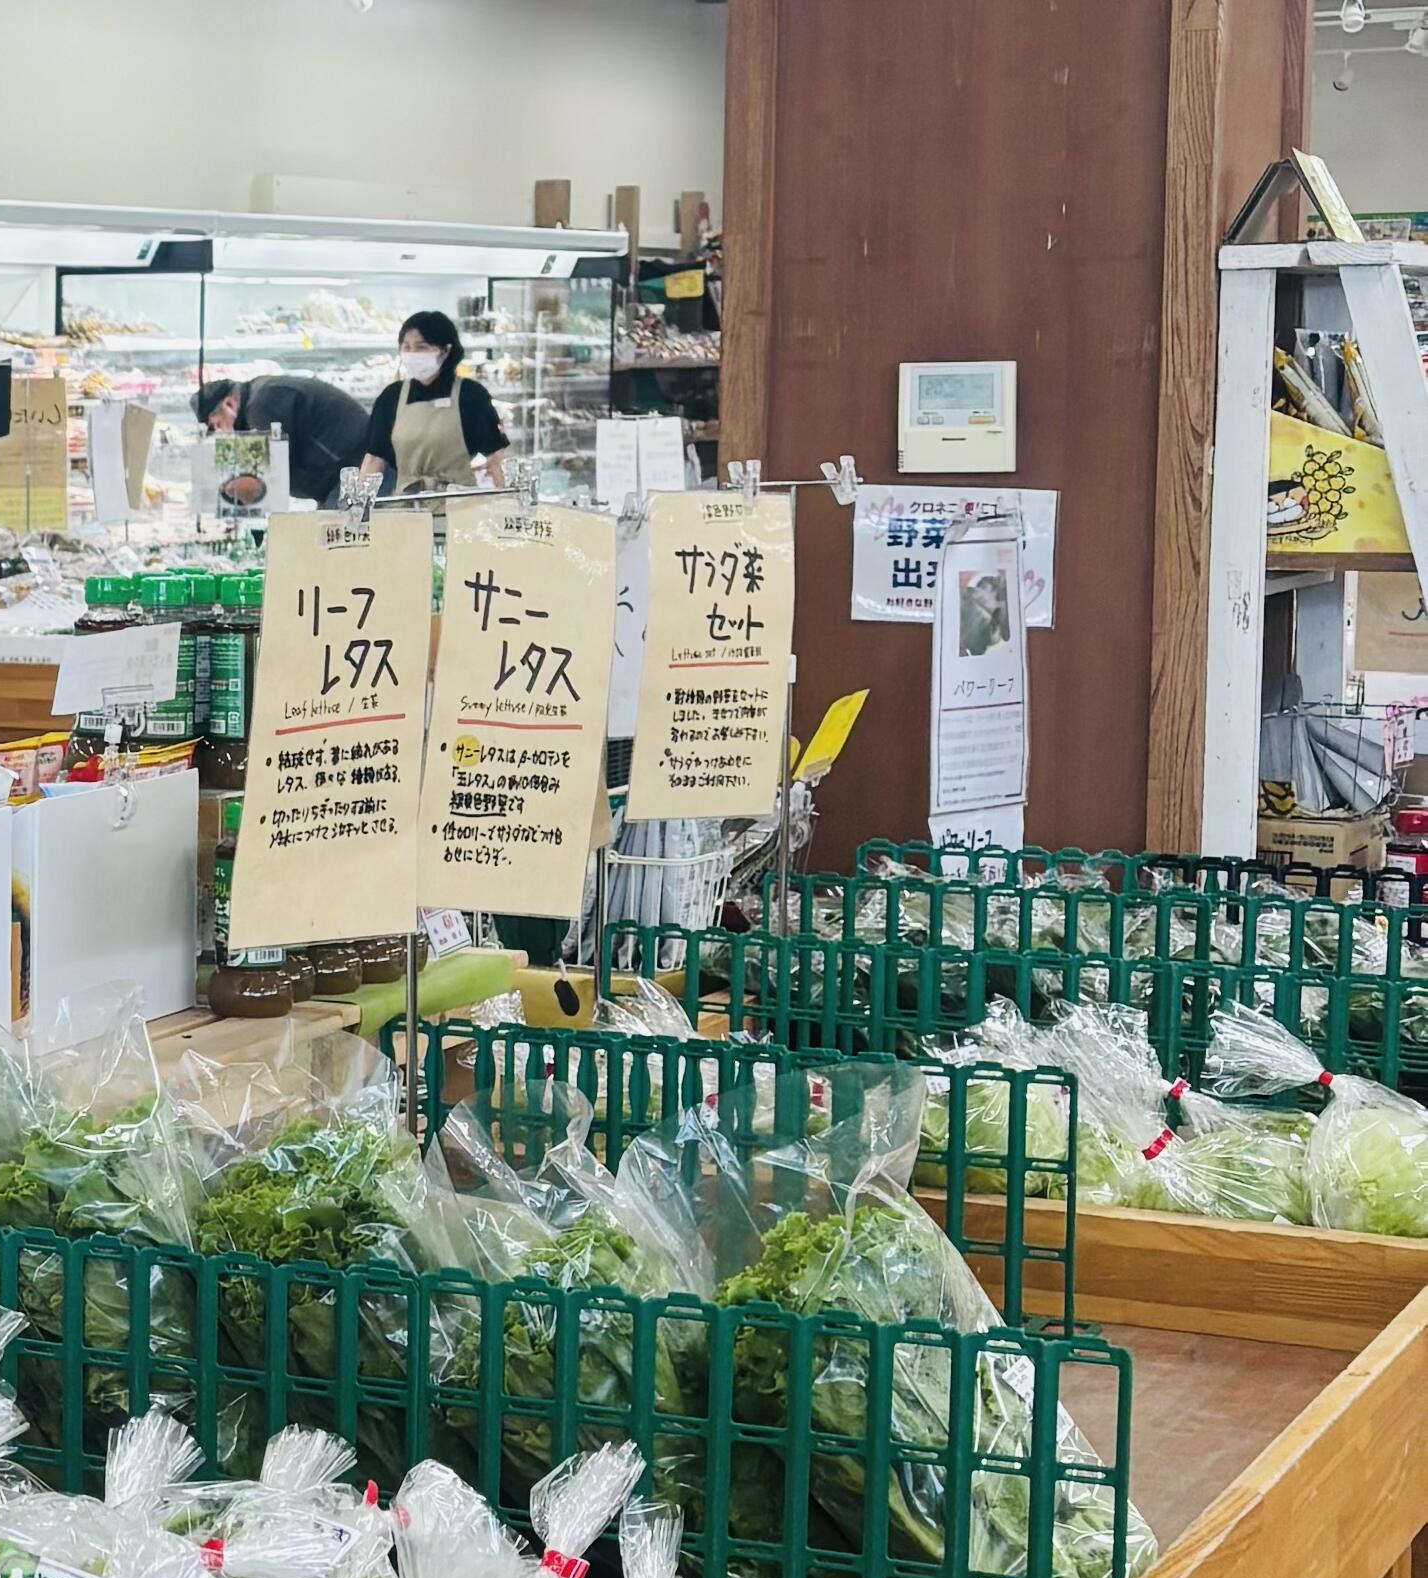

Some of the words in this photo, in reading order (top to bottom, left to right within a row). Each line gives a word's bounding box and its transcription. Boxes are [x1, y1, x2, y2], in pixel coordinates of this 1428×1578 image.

[675, 542, 765, 596] サラダ菜
[297, 585, 376, 637] リーフ
[464, 569, 549, 631] サニー
[706, 602, 765, 641] セット
[320, 638, 400, 696] レタス
[493, 640, 581, 702] レタス
